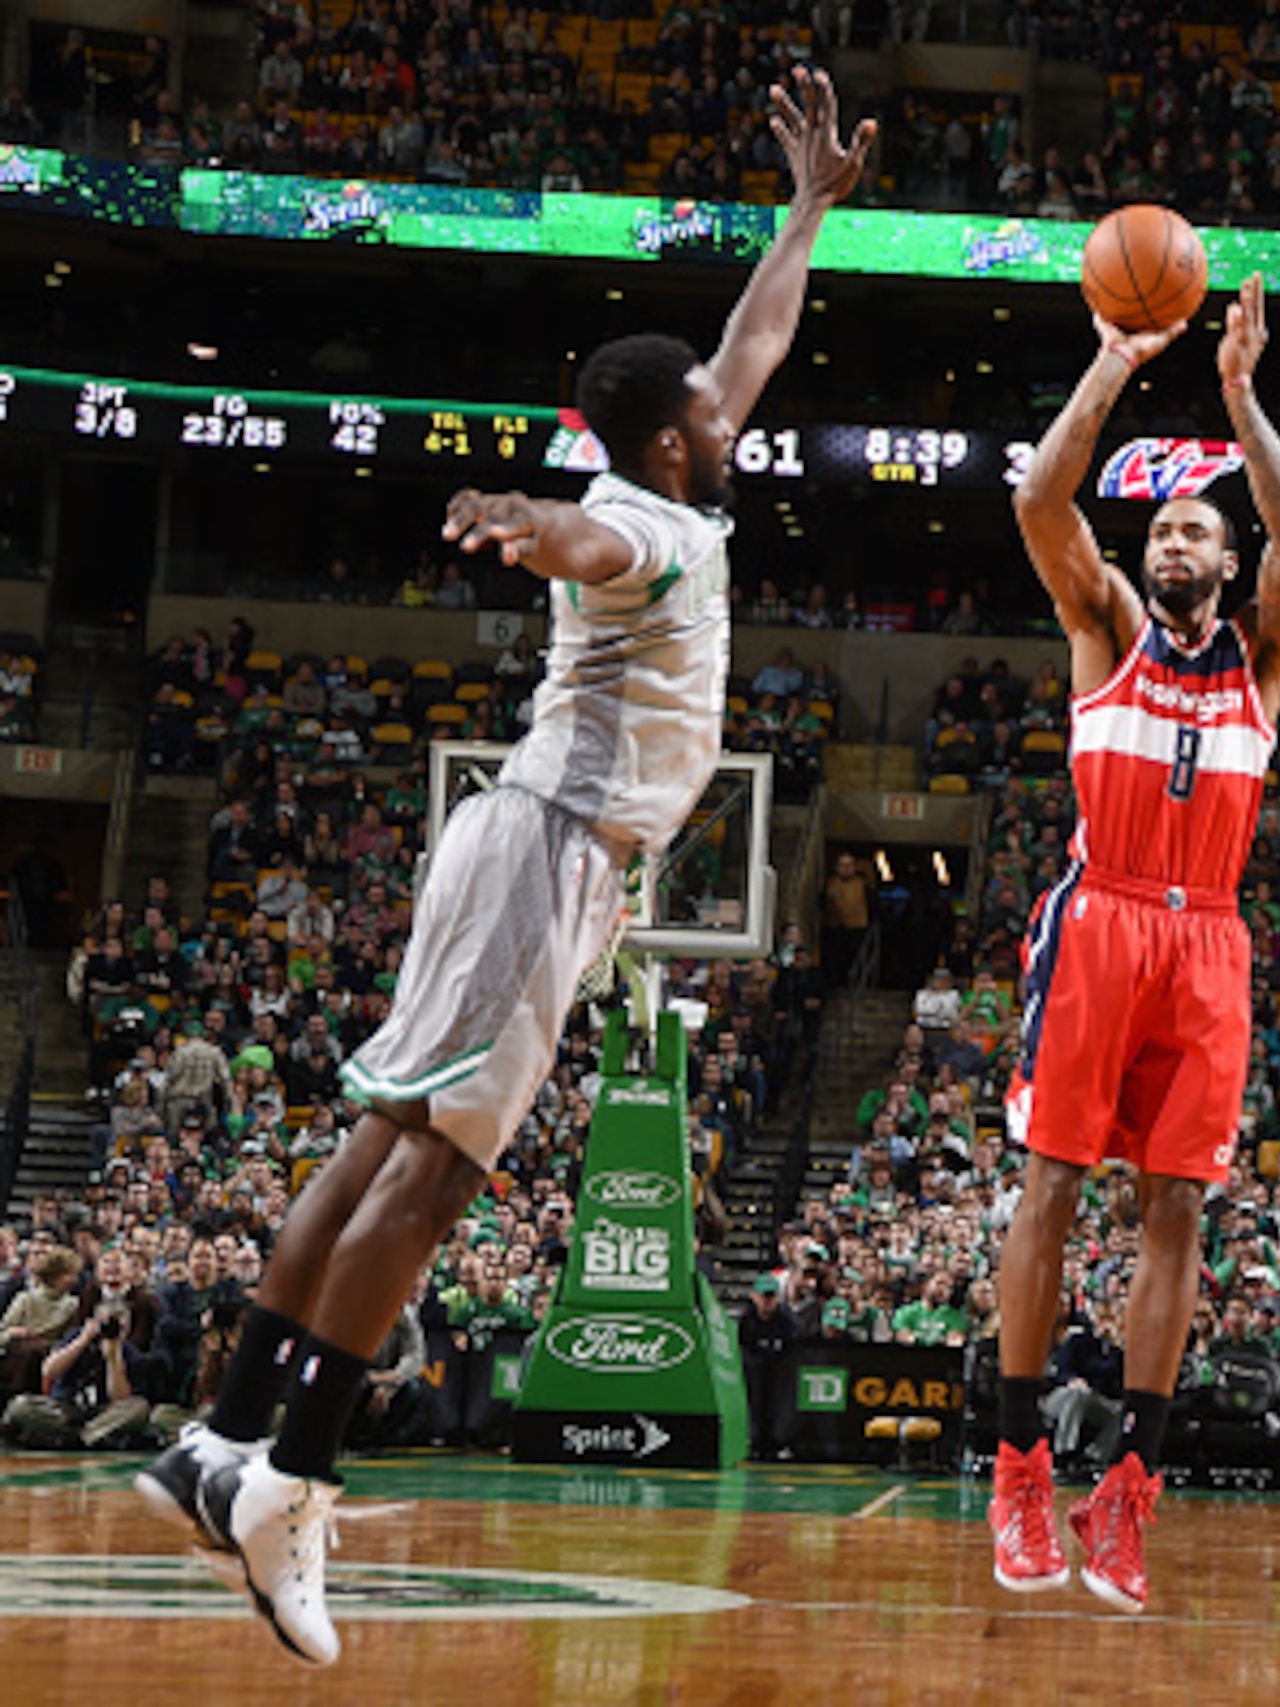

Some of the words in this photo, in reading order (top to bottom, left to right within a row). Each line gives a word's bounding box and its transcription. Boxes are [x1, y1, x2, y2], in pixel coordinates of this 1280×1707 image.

[80, 381, 128, 407] 3PT
[212, 395, 248, 416] FG
[331, 424, 377, 455] 42
[736, 429, 803, 475] 61
[864, 429, 968, 468] 8:39
[1167, 724, 1201, 799] 8
[602, 1174, 665, 1201] Ford
[584, 1239, 670, 1278] BIG
[572, 1324, 669, 1364] Ford
[802, 1373, 843, 1404] TD
[562, 1424, 636, 1456] Sprint
